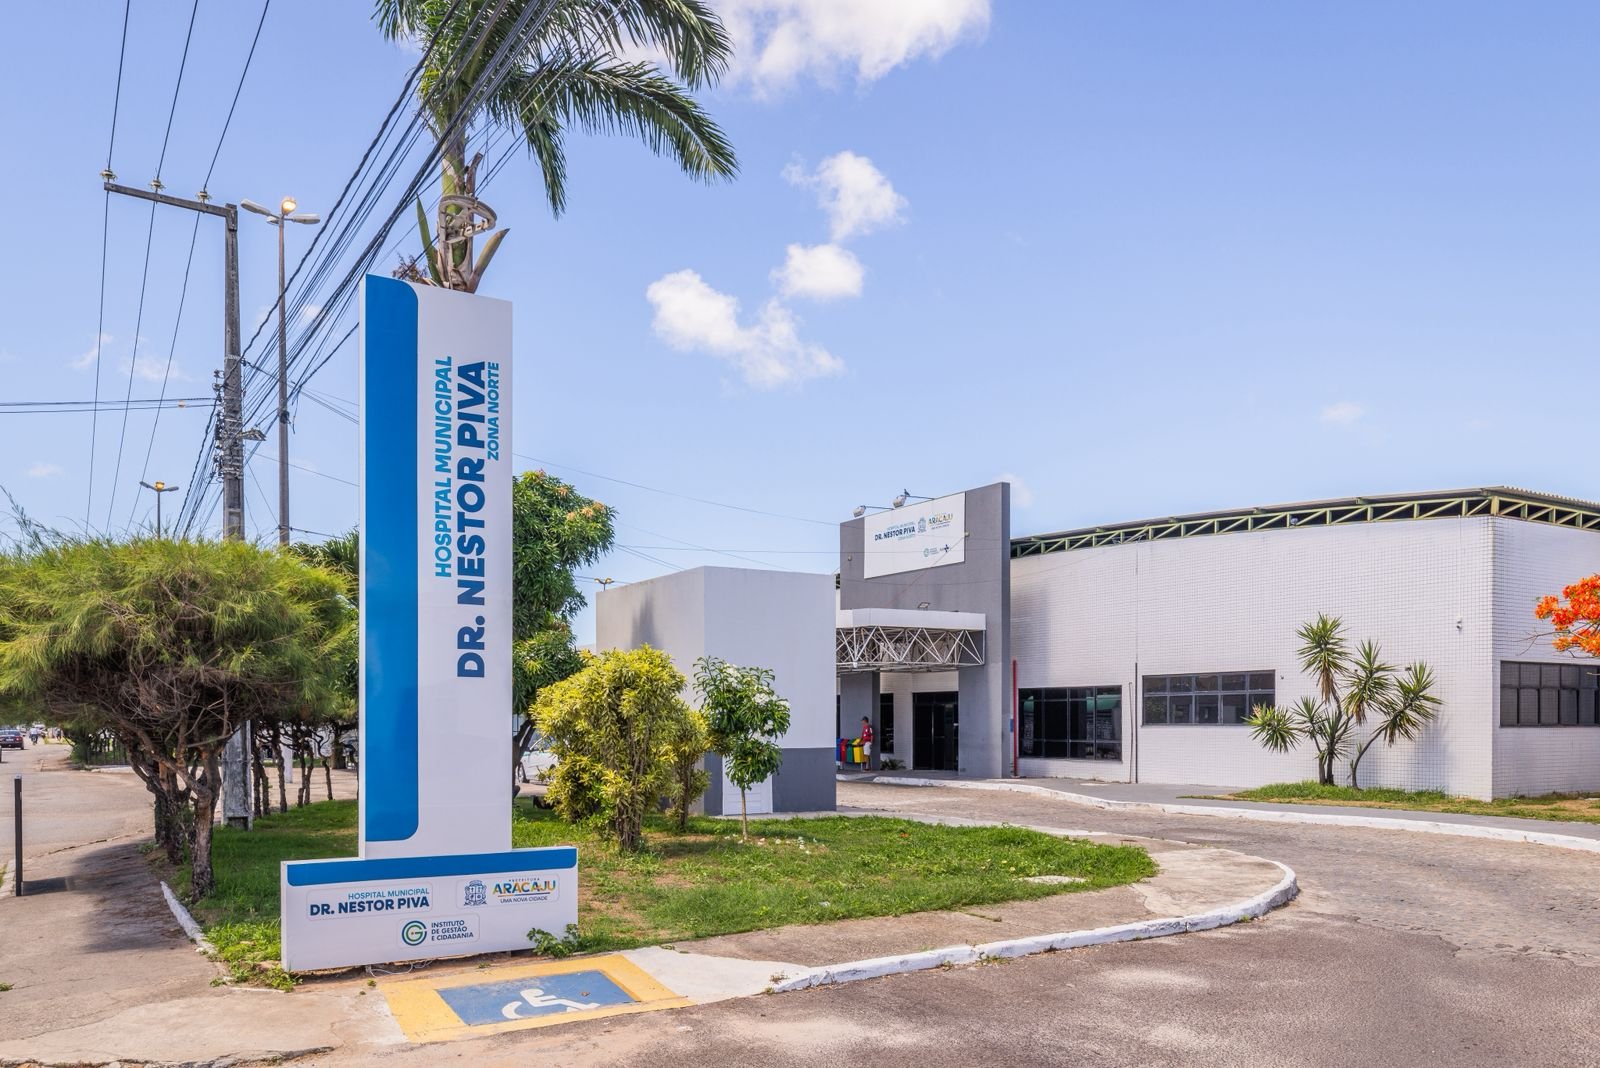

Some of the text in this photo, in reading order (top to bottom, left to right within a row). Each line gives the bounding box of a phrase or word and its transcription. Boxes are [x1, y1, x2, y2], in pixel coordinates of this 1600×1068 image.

[487, 362, 500, 461] ZONA NORTE
[434, 356, 452, 578] HOSPITAL MUNICIPAL
[456, 361, 486, 678] DR. NESTOR PIVA
[874, 533, 882, 541] DR.
[883, 529, 903, 539] NESTOR
[903, 526, 916, 535] PIVA
[348, 888, 430, 900] HOSPITAL MUNICIPAL
[493, 880, 556, 894] ARACAJU
[310, 896, 430, 916] DR. NESTOR PIVA
[431, 920, 465, 929] INSTITUTO
[441, 926, 468, 934] GESTÃO
[436, 932, 474, 941] CIDADANIA
